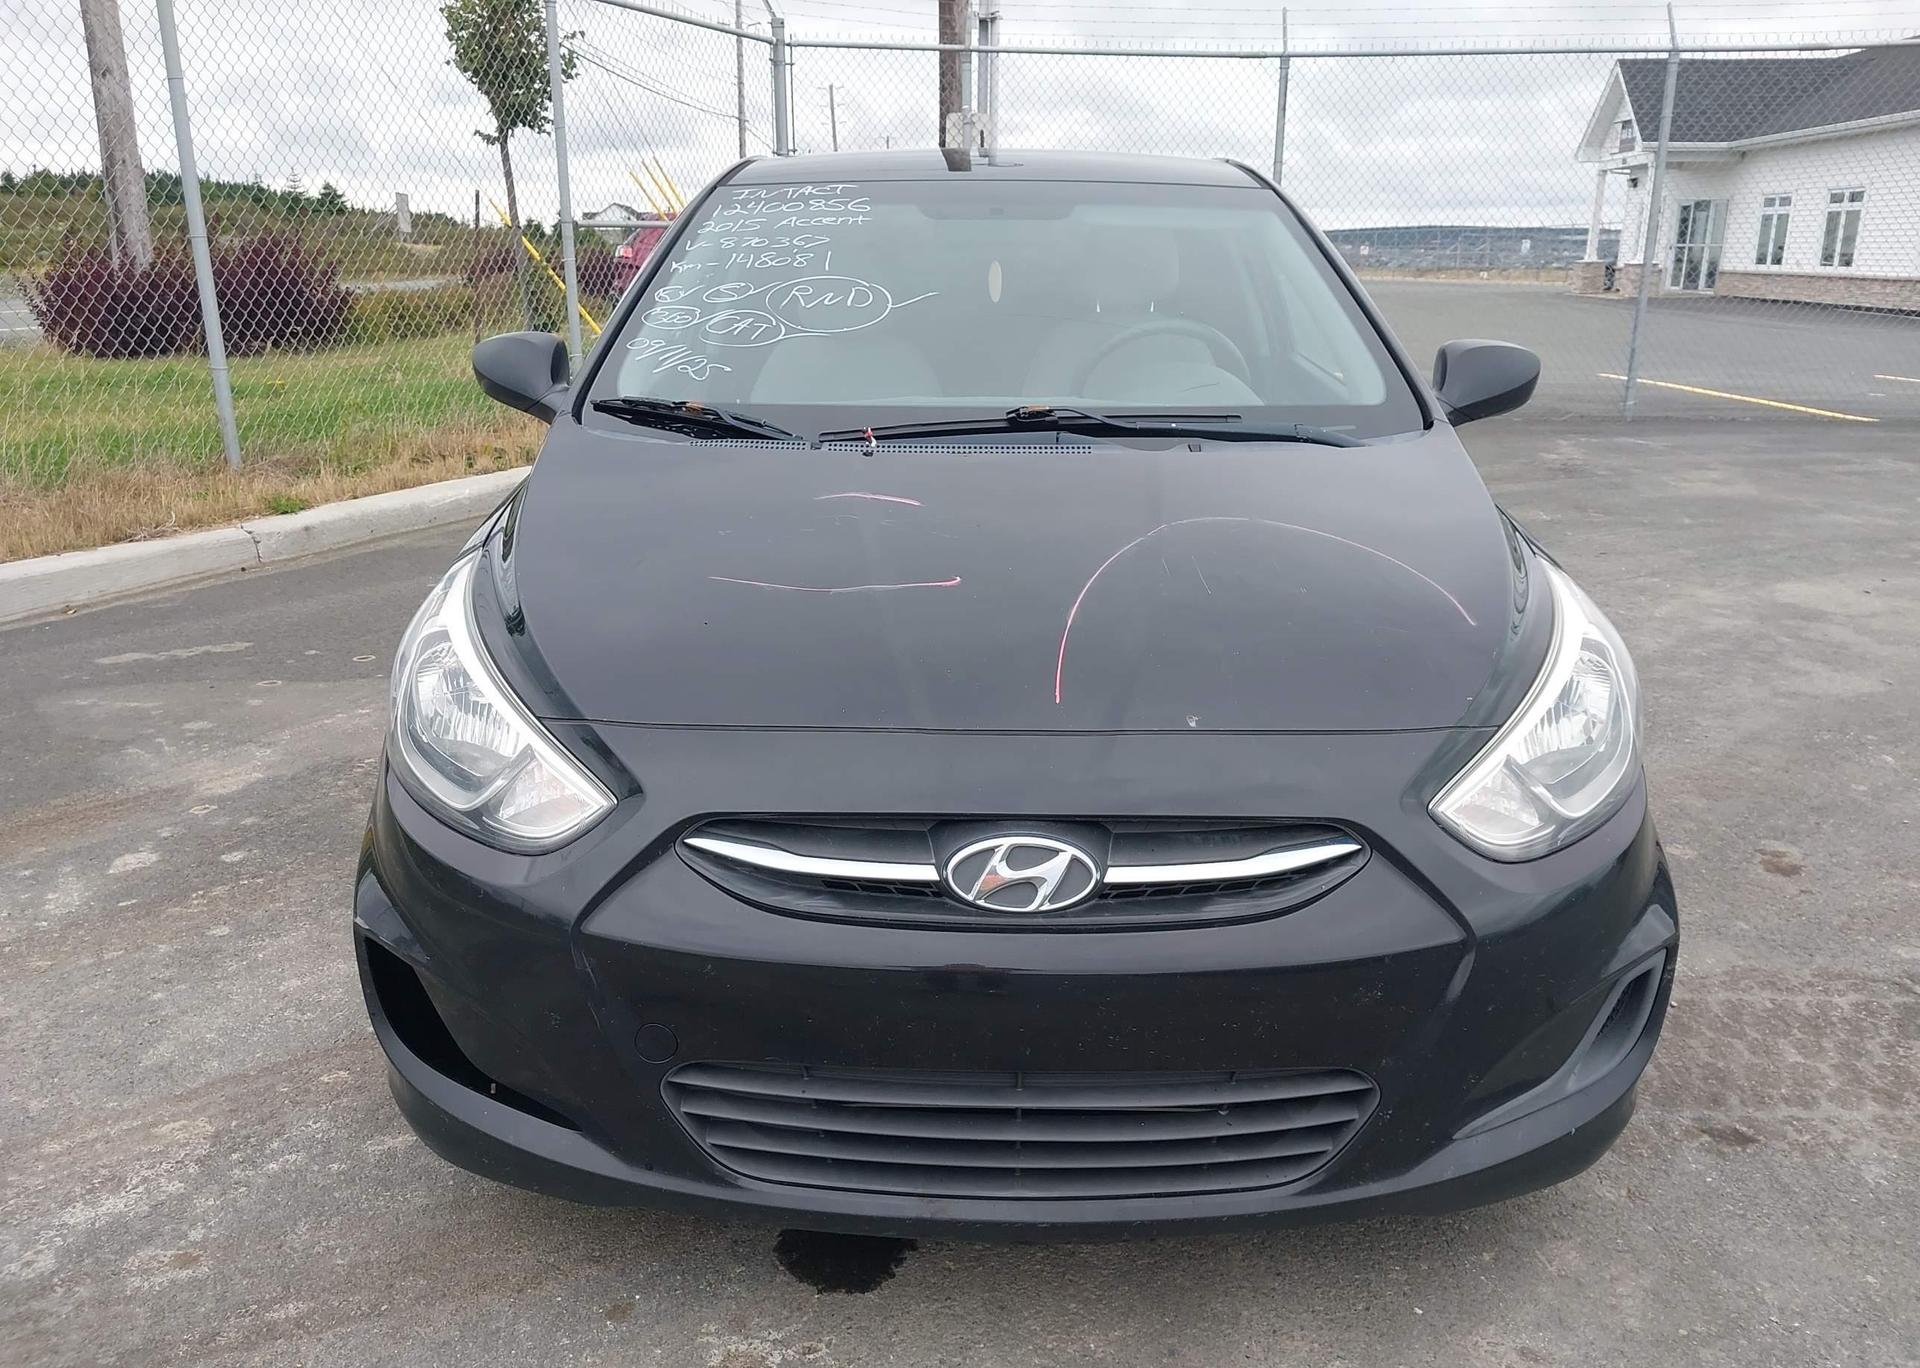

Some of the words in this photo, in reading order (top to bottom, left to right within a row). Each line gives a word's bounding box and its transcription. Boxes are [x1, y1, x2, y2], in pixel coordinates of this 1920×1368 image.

[732, 184, 859, 200] INTACT
[712, 198, 872, 217] 12400856
[697, 218, 768, 234] 2015
[705, 315, 773, 339] CAT
